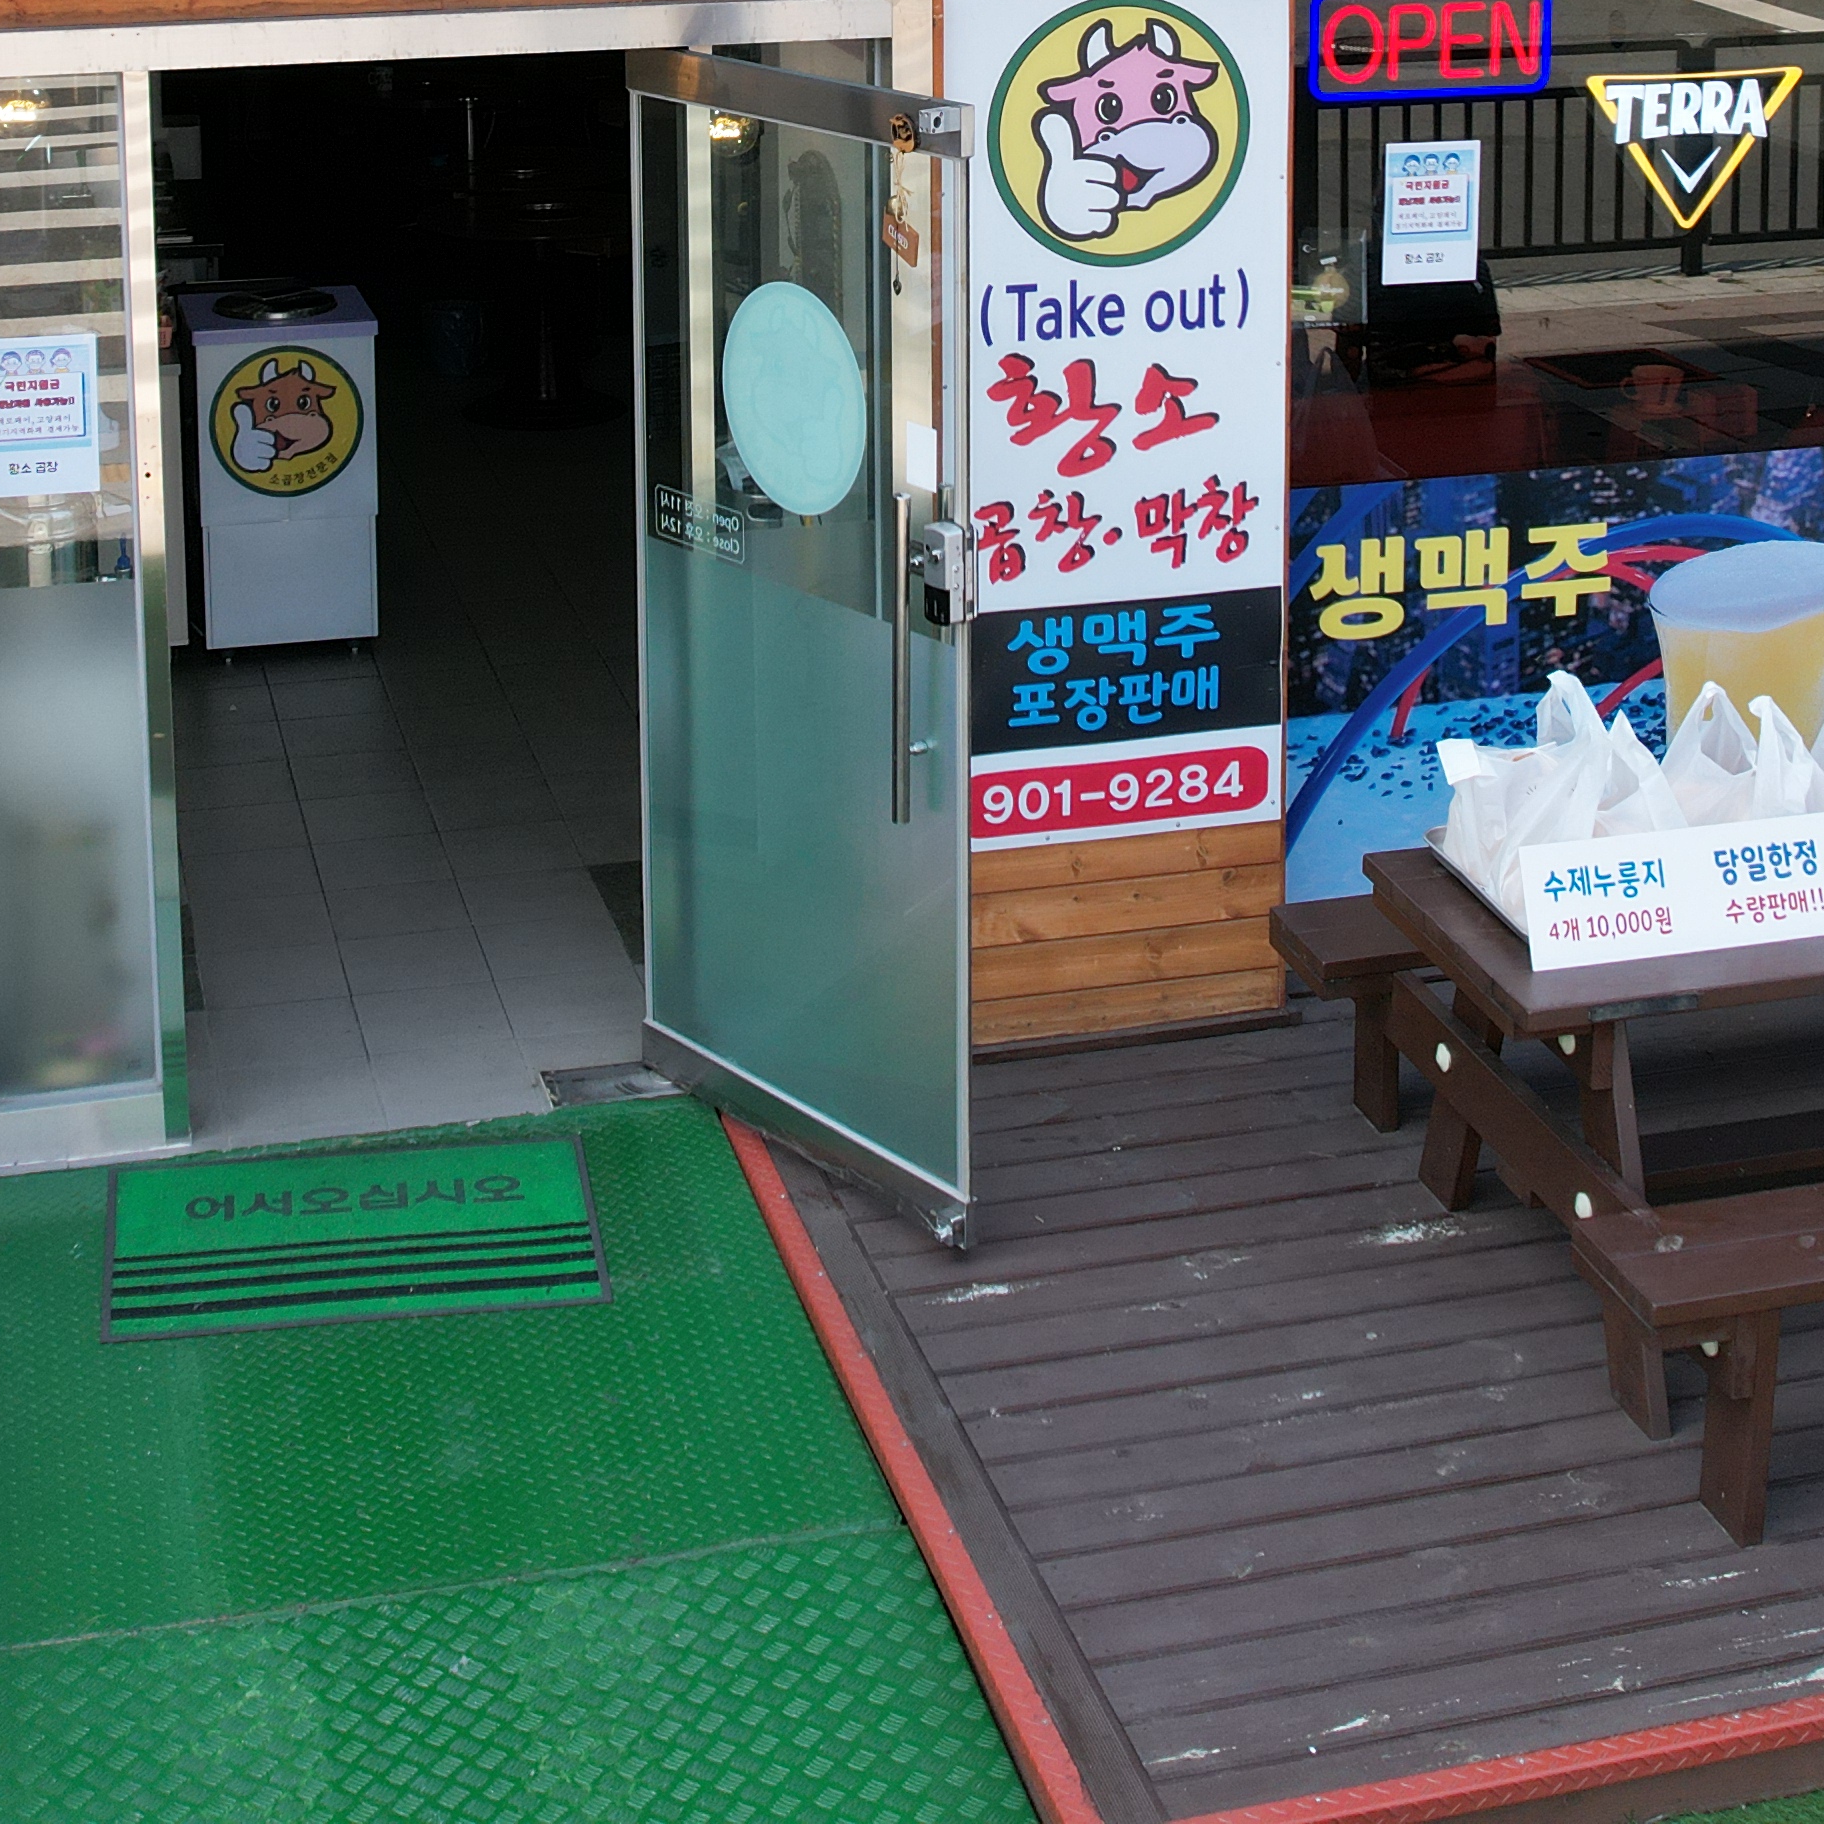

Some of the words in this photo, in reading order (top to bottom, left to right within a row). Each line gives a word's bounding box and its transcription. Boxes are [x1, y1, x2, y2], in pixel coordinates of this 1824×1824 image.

[1322, 0, 1541, 85] OPEN
[1606, 79, 1768, 144] TERRA
[981, 280, 1126, 348] (Take
[1145, 267, 1250, 333] out)
[988, 353, 1219, 478] 황소
[1310, 521, 1612, 641] 생맥주
[1007, 603, 1220, 675] 생맥주
[1008, 665, 1219, 732] 포장판매
[982, 760, 1244, 826] 901-9284
[1543, 858, 1666, 904] 수제누룽지
[1714, 839, 1819, 886] 당일한정
[1548, 917, 1581, 942] 4개
[1586, 906, 1673, 940] 10,000원
[185, 1175, 526, 1222] 어서오십시오
